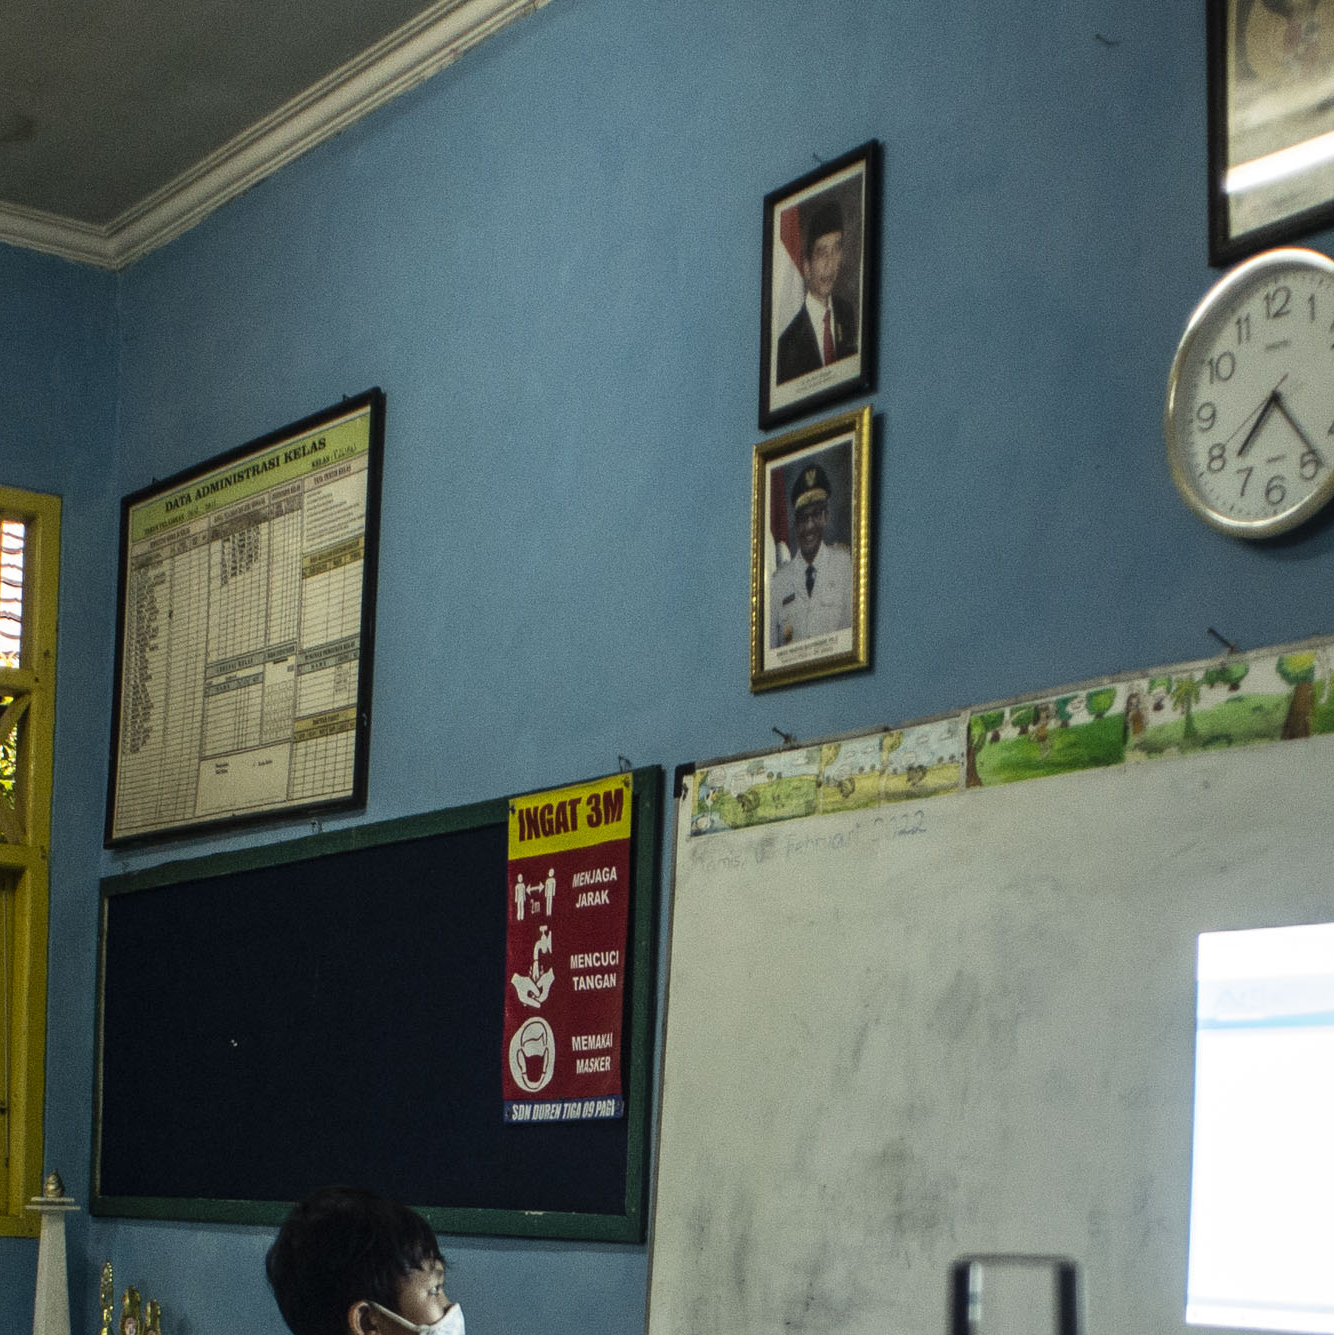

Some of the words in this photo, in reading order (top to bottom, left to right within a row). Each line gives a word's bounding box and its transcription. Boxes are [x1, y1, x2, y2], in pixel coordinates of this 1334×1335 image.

[1266, 286, 1292, 318] 12
[1308, 294, 1316, 323] 1
[1235, 313, 1251, 345] 11
[1208, 351, 1236, 384] 10
[1197, 402, 1216, 432] 9
[1208, 443, 1227, 472] 8
[165, 494, 192, 512] DATA
[195, 458, 280, 500] ADMINISTRASI
[284, 437, 327, 464] KELAS
[1237, 466, 1254, 497] 7
[1265, 475, 1286, 505] 6
[518, 796, 582, 842] INGAT
[587, 788, 624, 828] 3M
[572, 866, 618, 889] MENJAGA
[575, 889, 610, 909] JARAK
[570, 950, 619, 970] MENCUCI
[572, 973, 617, 992] TANGAN
[571, 1032, 613, 1052] MEMAKAI
[576, 1056, 611, 1075] MASKER
[512, 1103, 531, 1121] SDN
[531, 1103, 562, 1121] DUREN
[562, 1102, 582, 1120] TIGA
[583, 1100, 595, 1119] 09
[594, 1098, 616, 1118] PAGI
